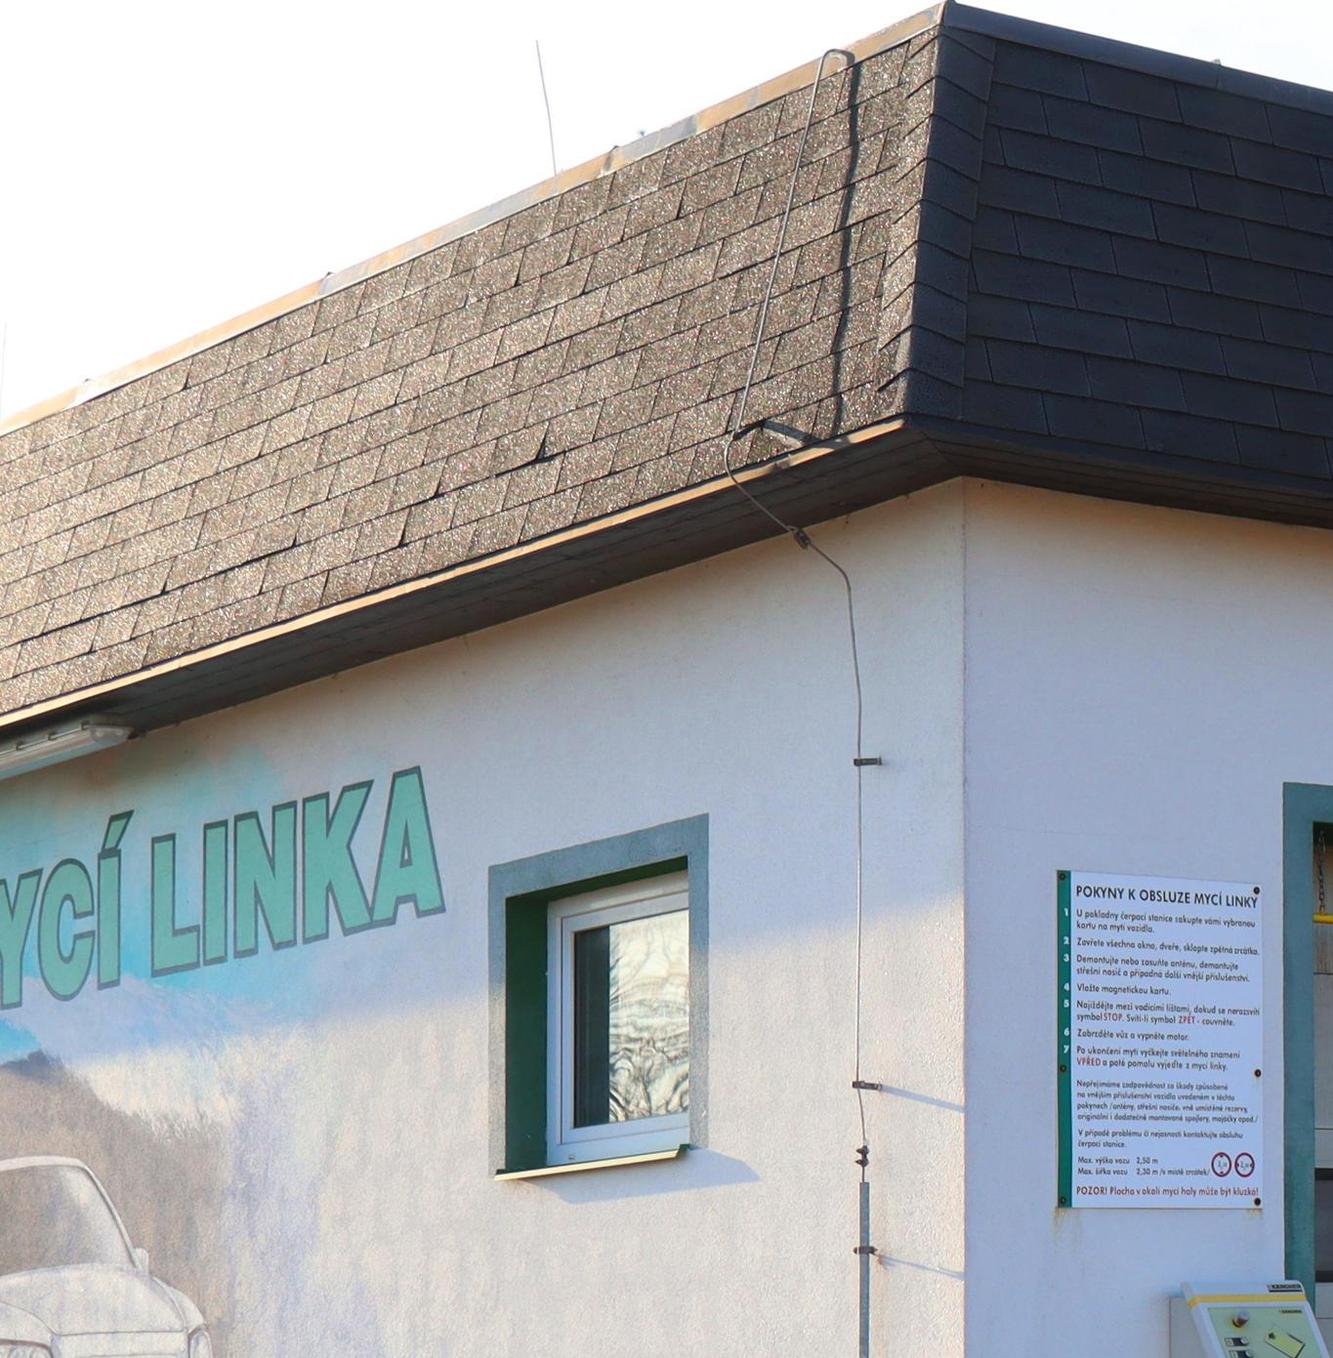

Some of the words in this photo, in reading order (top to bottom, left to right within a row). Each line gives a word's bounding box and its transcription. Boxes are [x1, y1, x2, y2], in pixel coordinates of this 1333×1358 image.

[0, 809, 135, 1010] YCÍ
[151, 765, 446, 978] LINKA
[1077, 886, 1124, 900] POKYNY
[1129, 889, 1135, 900] K
[1140, 889, 1190, 904] OBSLUZE
[1194, 890, 1222, 906] MYCÍ
[1226, 895, 1257, 908] LINKY
[1064, 908, 1068, 916] 1
[1077, 909, 1082, 917] U
[1085, 910, 1119, 921] pokladny
[1149, 914, 1172, 922] stanice
[1175, 915, 1202, 926] zakupte
[1223, 918, 1255, 929] vybranou
[1077, 920, 1096, 929] kartu
[1128, 923, 1154, 933] vozidla.
[1064, 936, 1070, 944] 2
[1077, 937, 1104, 946] Zavřete
[1107, 939, 1135, 948] všechna
[1184, 944, 1208, 954] sklopte
[1064, 954, 1070, 962] 3
[1077, 954, 1118, 966] Demontujte
[1121, 956, 1139, 966] nebo
[1199, 960, 1238, 972] demontujte
[1103, 967, 1121, 976] nosič
[1064, 982, 1070, 991] 4
[1077, 983, 1099, 992] Vložte
[1102, 984, 1147, 996] magnetickou
[1064, 1000, 1070, 1008] 5
[1194, 1005, 1216, 1014] dokud
[1077, 1012, 1102, 1022] symbol
[1150, 1015, 1175, 1025] symbol
[1064, 1028, 1070, 1036] 6
[1064, 1045, 1070, 1053] 7
[1077, 1046, 1085, 1054] Po
[1128, 1058, 1154, 1069] pomalu
[1110, 1186, 1135, 1195] Plocha
[1181, 1187, 1196, 1196] haly
